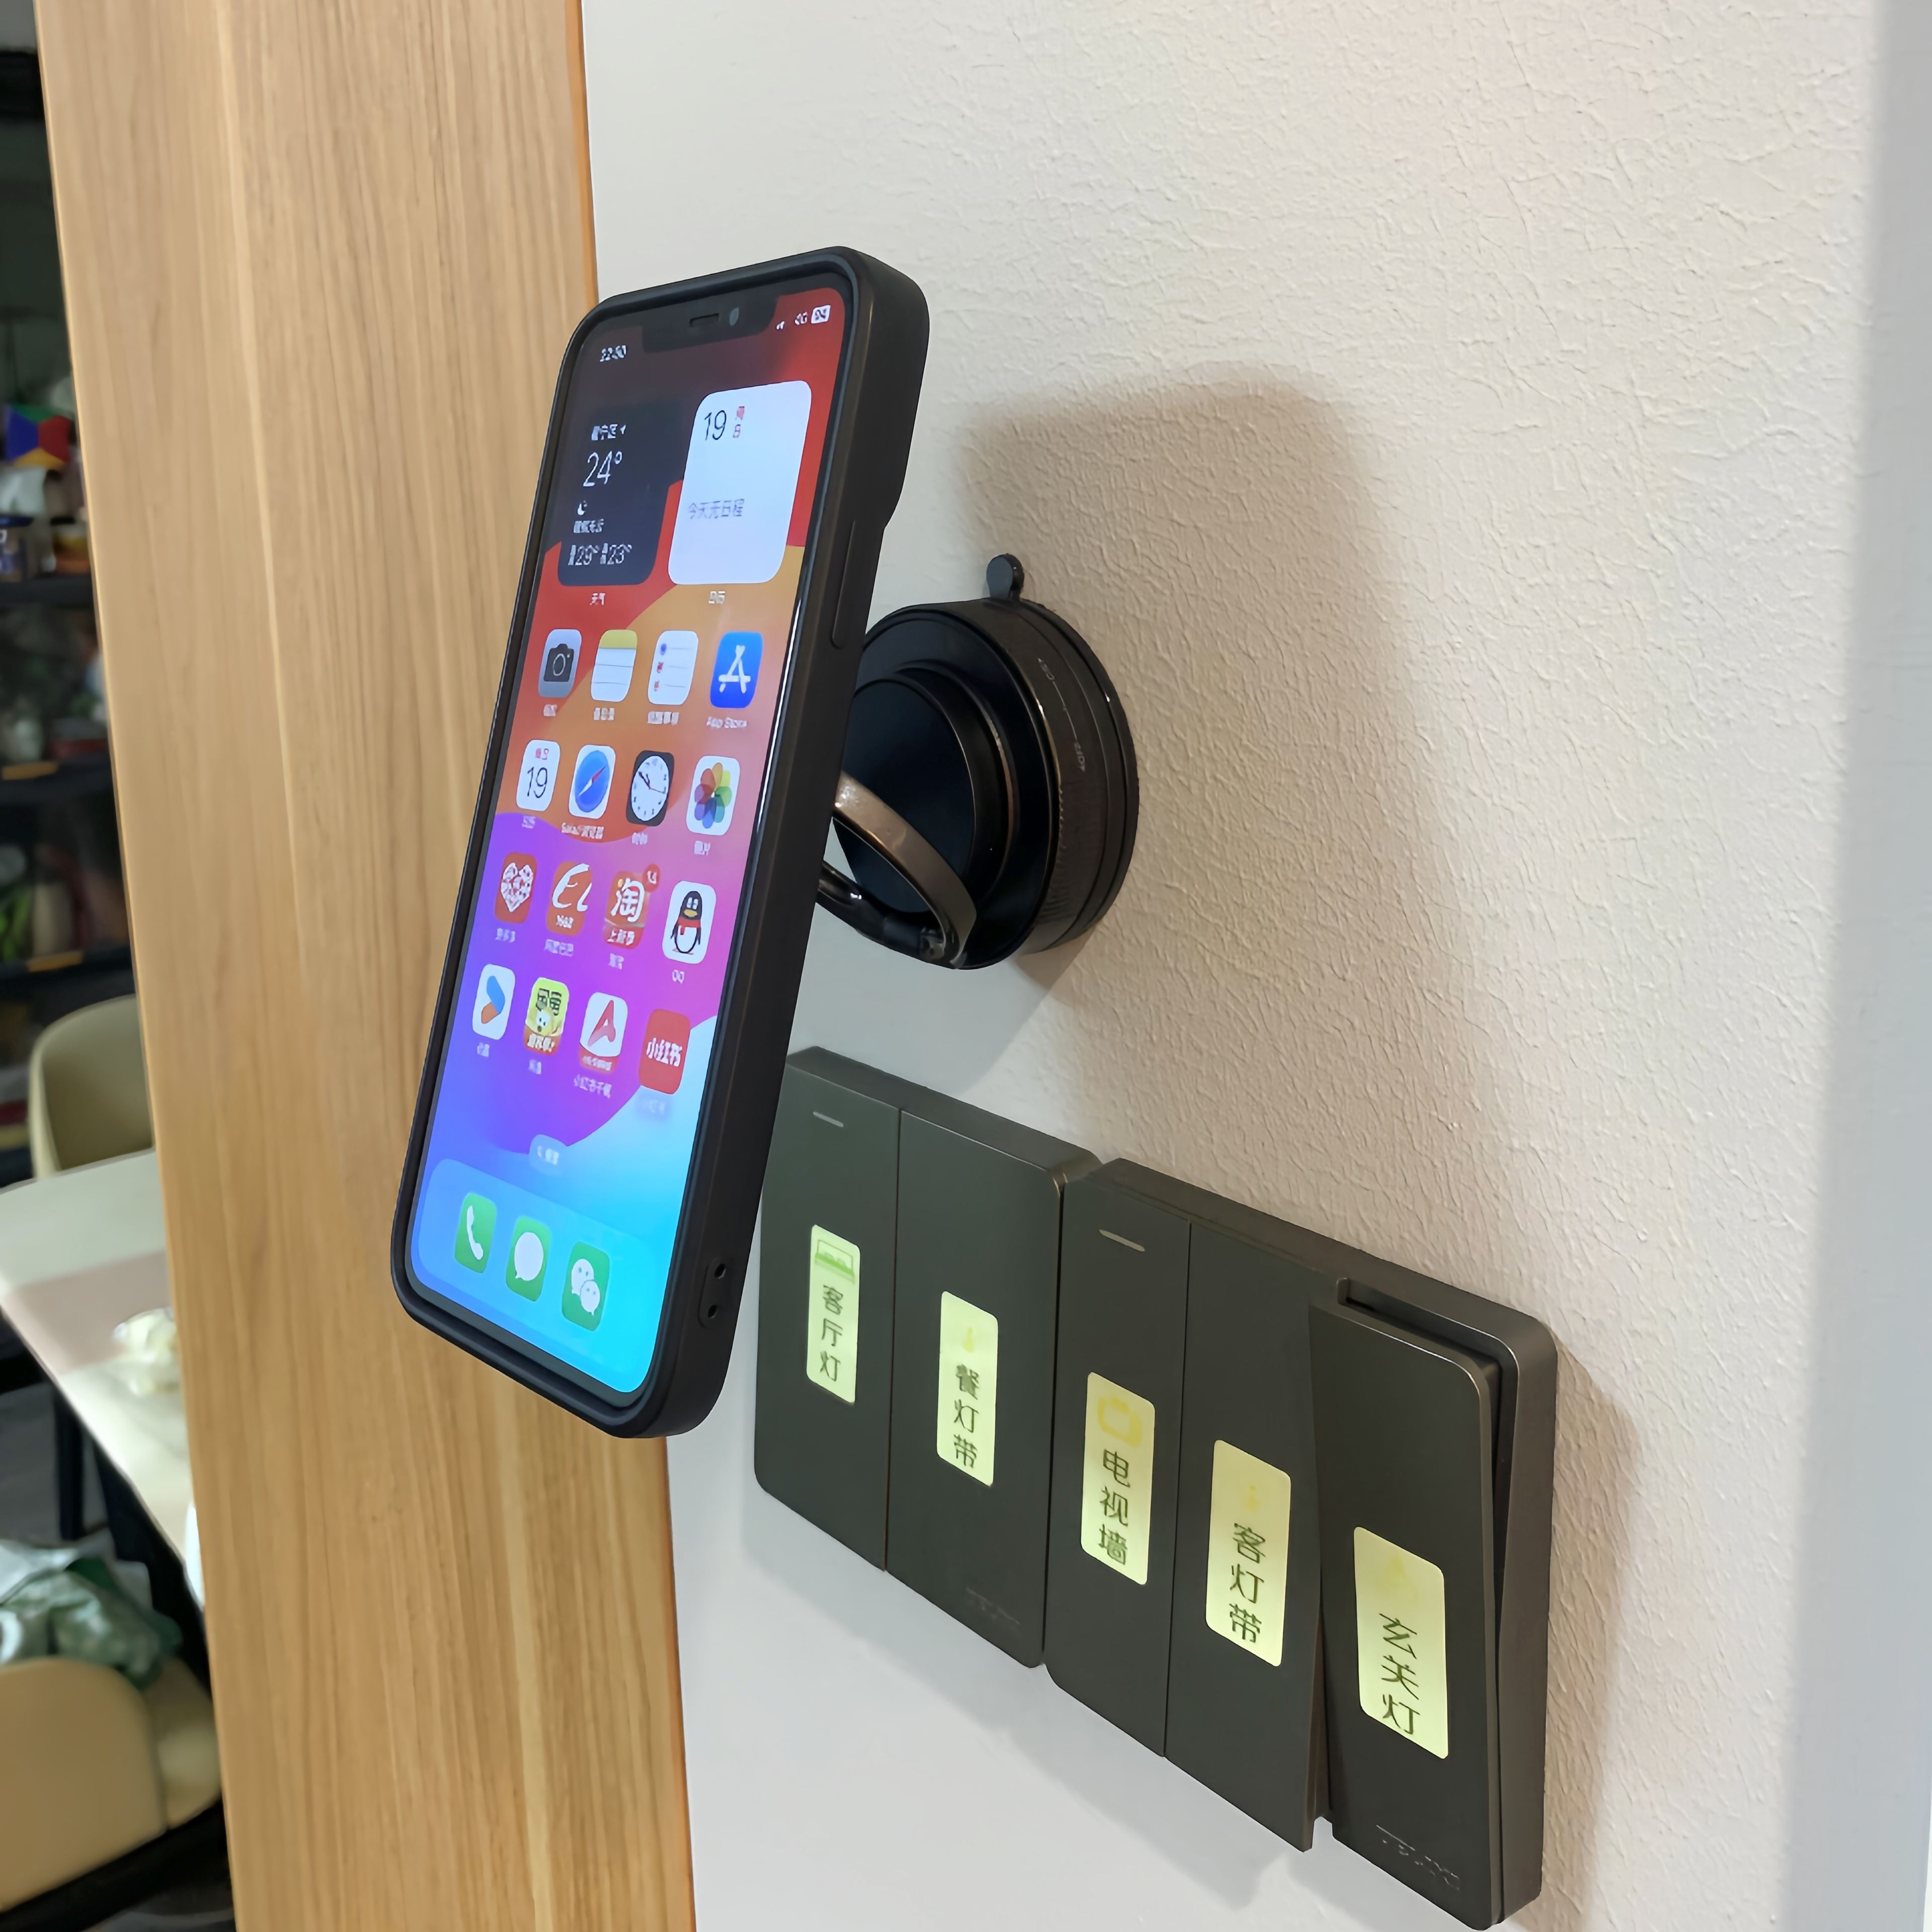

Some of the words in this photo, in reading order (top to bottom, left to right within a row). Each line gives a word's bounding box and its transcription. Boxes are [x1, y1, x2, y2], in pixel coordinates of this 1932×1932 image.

[704, 410, 727, 441] 19
[527, 766, 548, 798] 19
[610, 877, 645, 922] 淘
[820, 1284, 843, 1382] 客厅灯
[1098, 1448, 1131, 1566] 电视墙
[1228, 1522, 1266, 1644] 客灯带
[1379, 1613, 1421, 1736] 玄关灯
